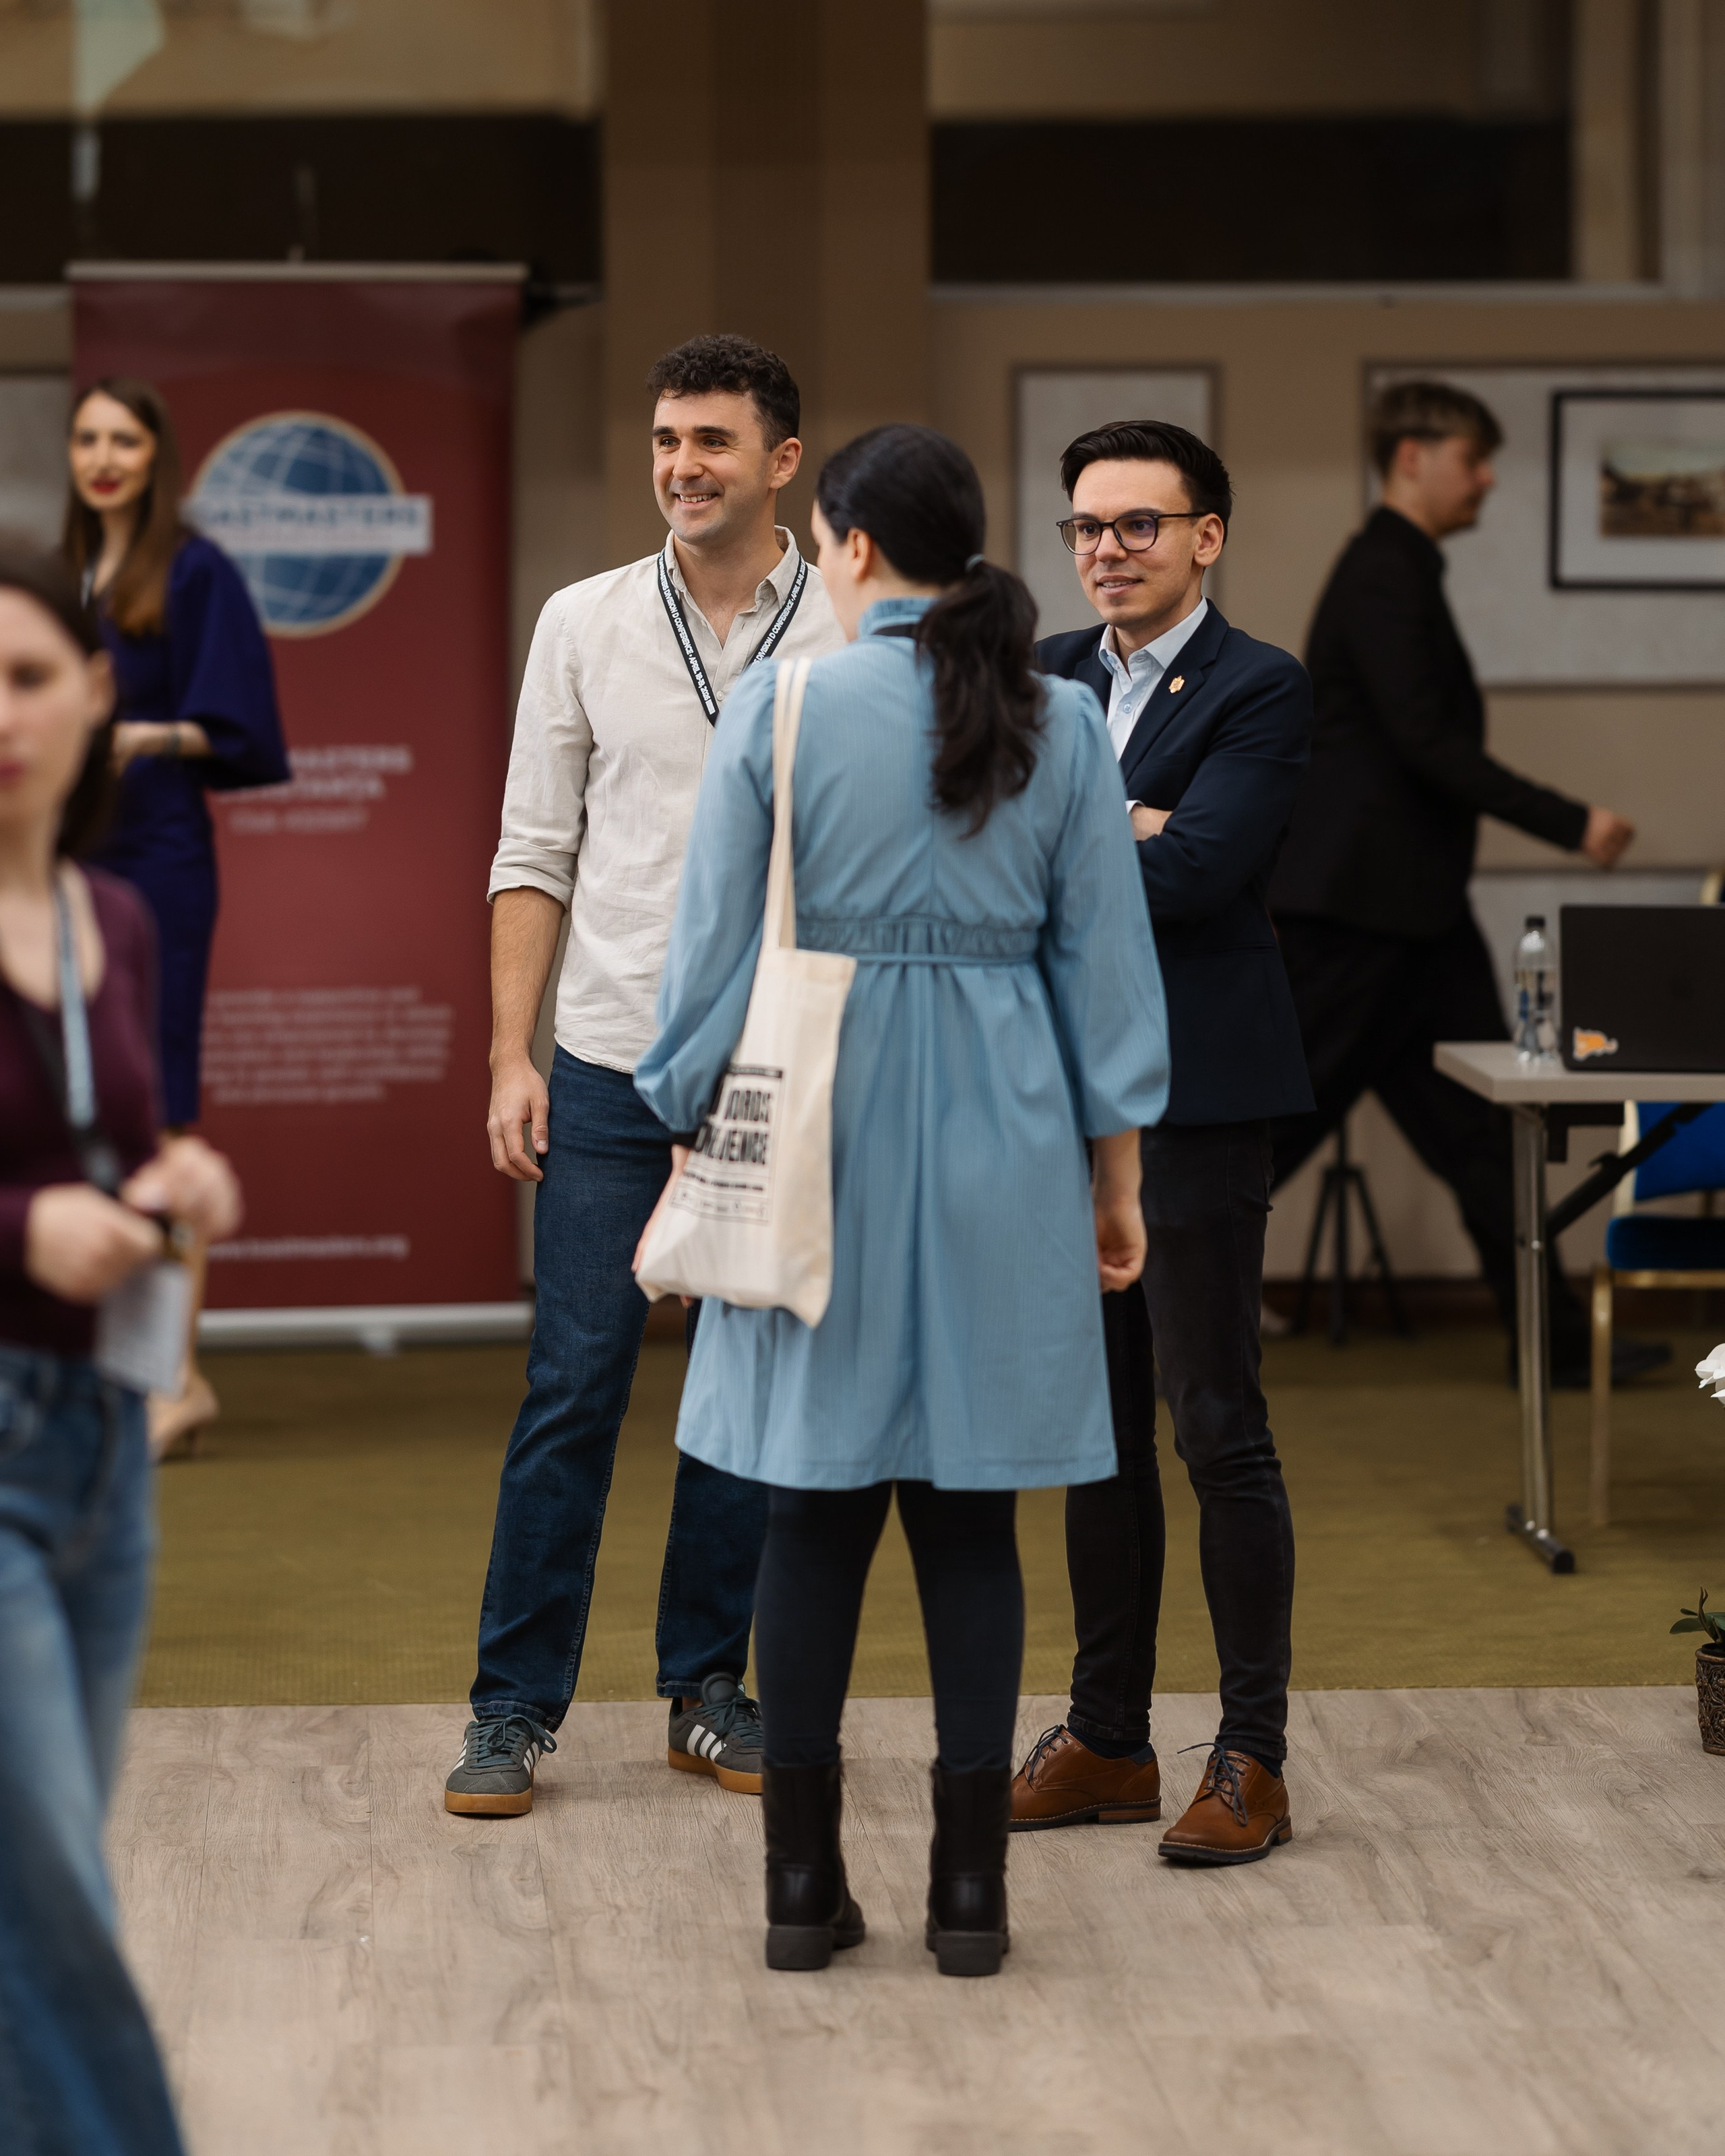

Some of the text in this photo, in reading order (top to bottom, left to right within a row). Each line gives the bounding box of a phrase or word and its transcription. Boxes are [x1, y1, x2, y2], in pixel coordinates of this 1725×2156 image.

[663, 589, 678, 614] DIVISION
[674, 617, 694, 656] CONFERENCE
[689, 657, 699, 674] APRIL
[755, 637, 774, 661] DIVISION
[772, 599, 794, 635] CONFERENCE
[791, 584, 801, 600] APRIL
